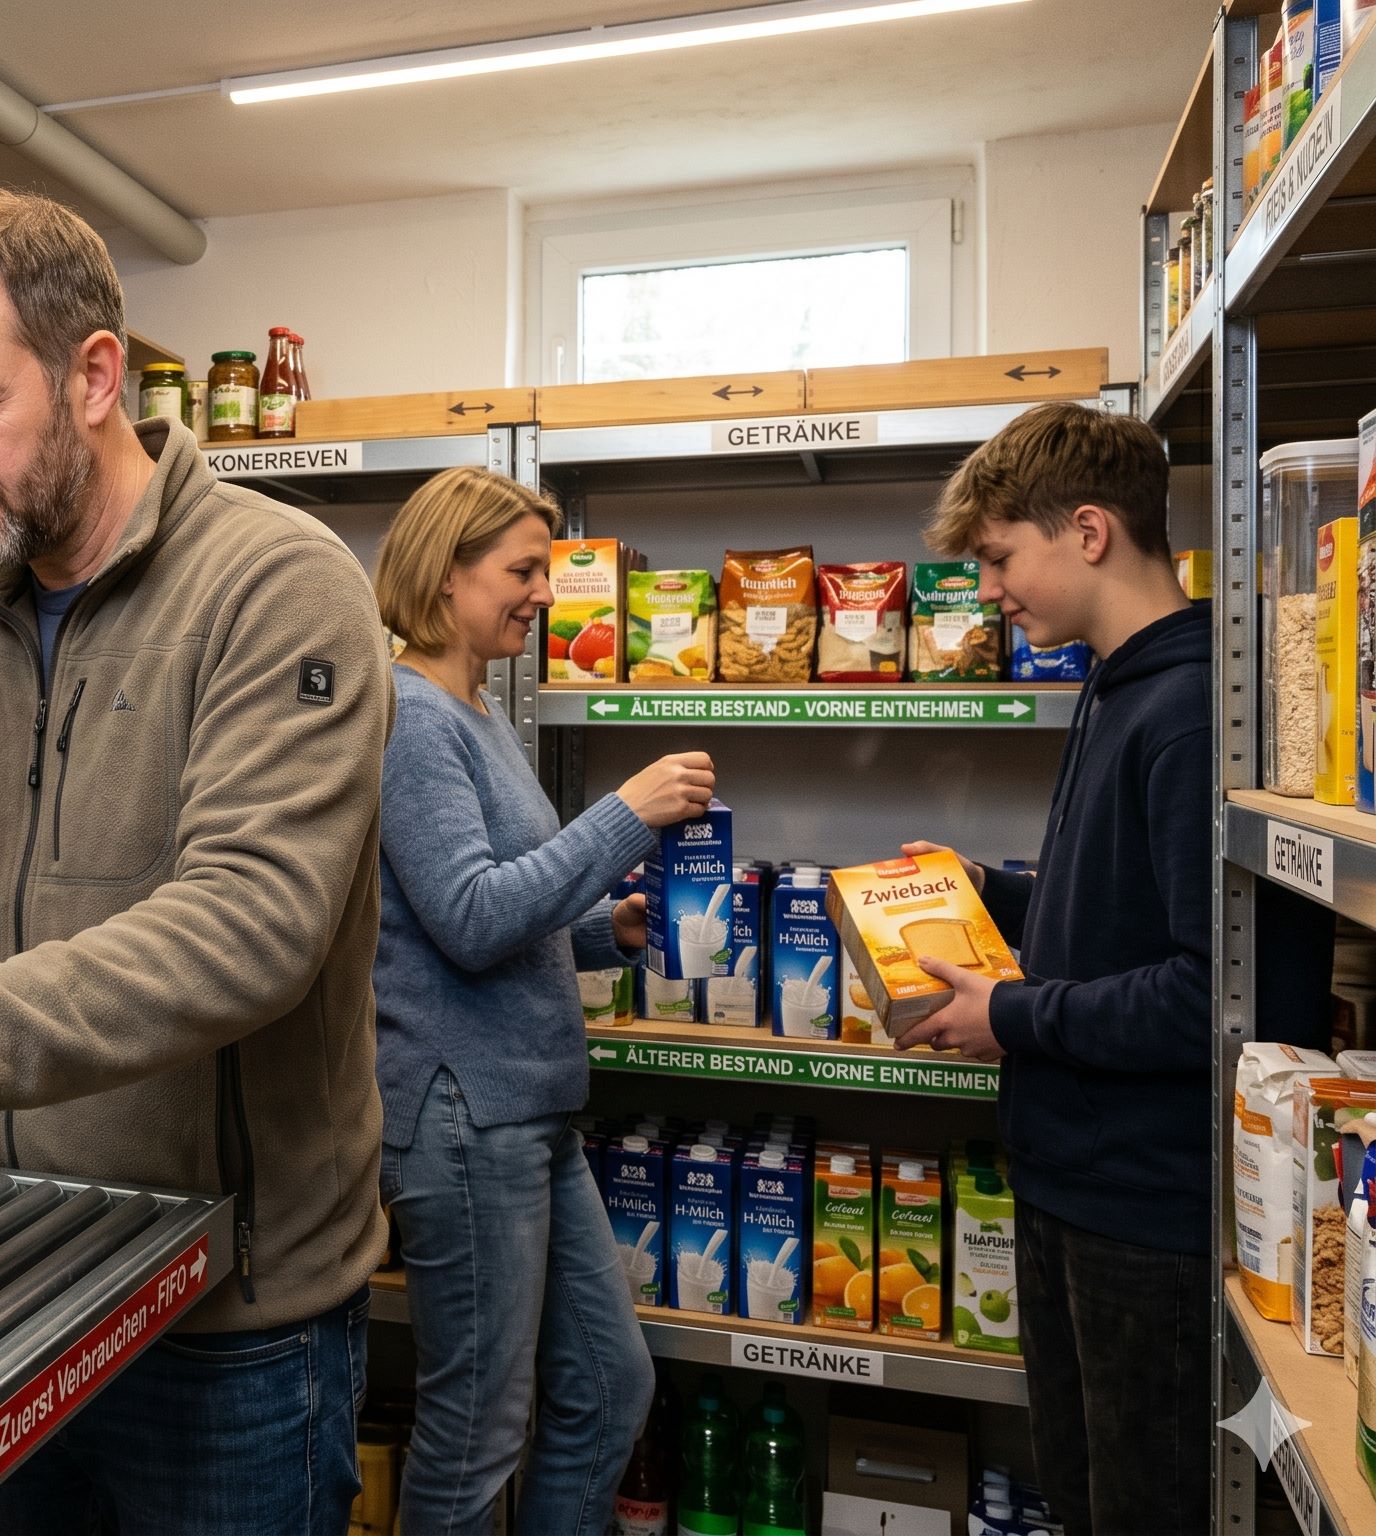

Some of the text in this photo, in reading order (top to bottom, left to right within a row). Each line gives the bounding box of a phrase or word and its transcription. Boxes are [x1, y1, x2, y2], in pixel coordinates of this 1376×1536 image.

[726, 419, 862, 447] GETRÄNKE
[208, 447, 348, 473] KONERREVEN
[630, 697, 707, 717] ÄLTERER
[710, 700, 790, 717] BESTAND
[804, 701, 869, 718] VORNE
[871, 701, 984, 718] ENTNEHMEN
[674, 860, 726, 875] H-Milch
[860, 876, 959, 906] Zwieback
[779, 933, 829, 946] H-Milch
[626, 1047, 705, 1070] ÄLTERER
[710, 1054, 794, 1076] BESTAND
[809, 1061, 875, 1082] VORNE
[879, 1066, 1000, 1092] ENTNEHMEN
[608, 1197, 657, 1213] H-Milch
[675, 1204, 725, 1220] H-Milch
[744, 1212, 795, 1228] H-Milch
[57, 1305, 147, 1403] Verbrauchen
[157, 1264, 187, 1315] FIFO
[743, 1342, 871, 1377] GETRÄNKE
